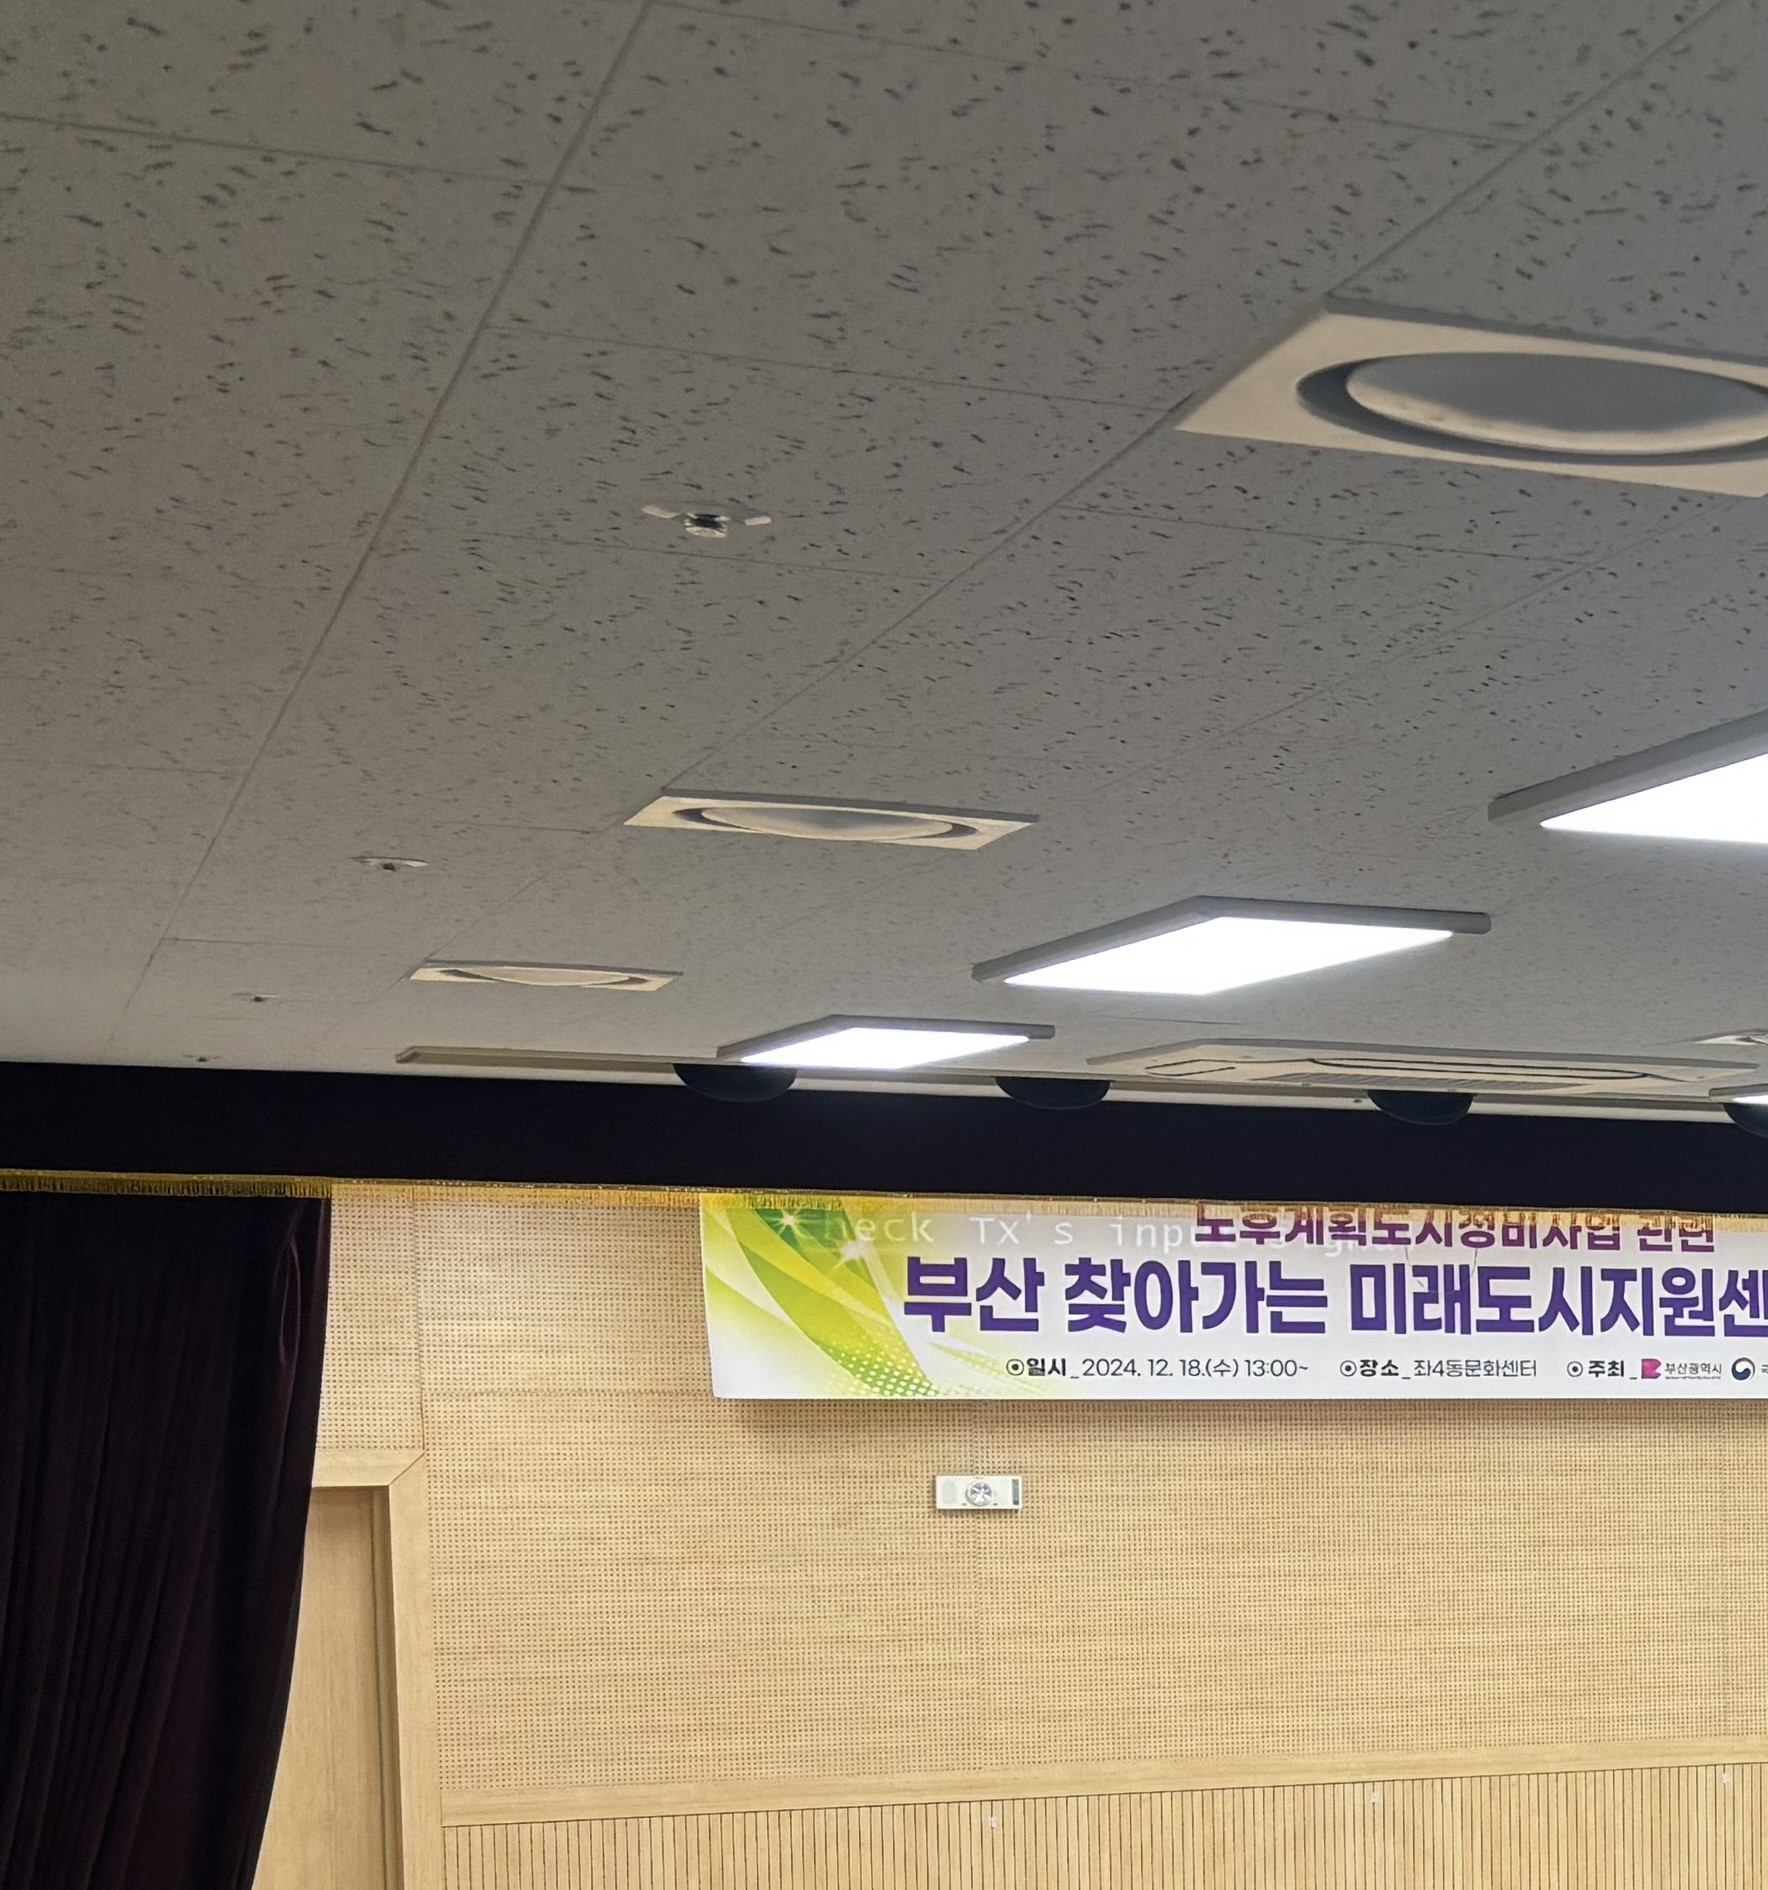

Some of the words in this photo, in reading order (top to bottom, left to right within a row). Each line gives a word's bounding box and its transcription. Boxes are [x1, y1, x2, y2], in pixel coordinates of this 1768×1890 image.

[903, 1256, 1045, 1334] 부산
[1064, 1257, 1328, 1335] 찾아가는
[1664, 1362, 1723, 1376] 부산광역시
